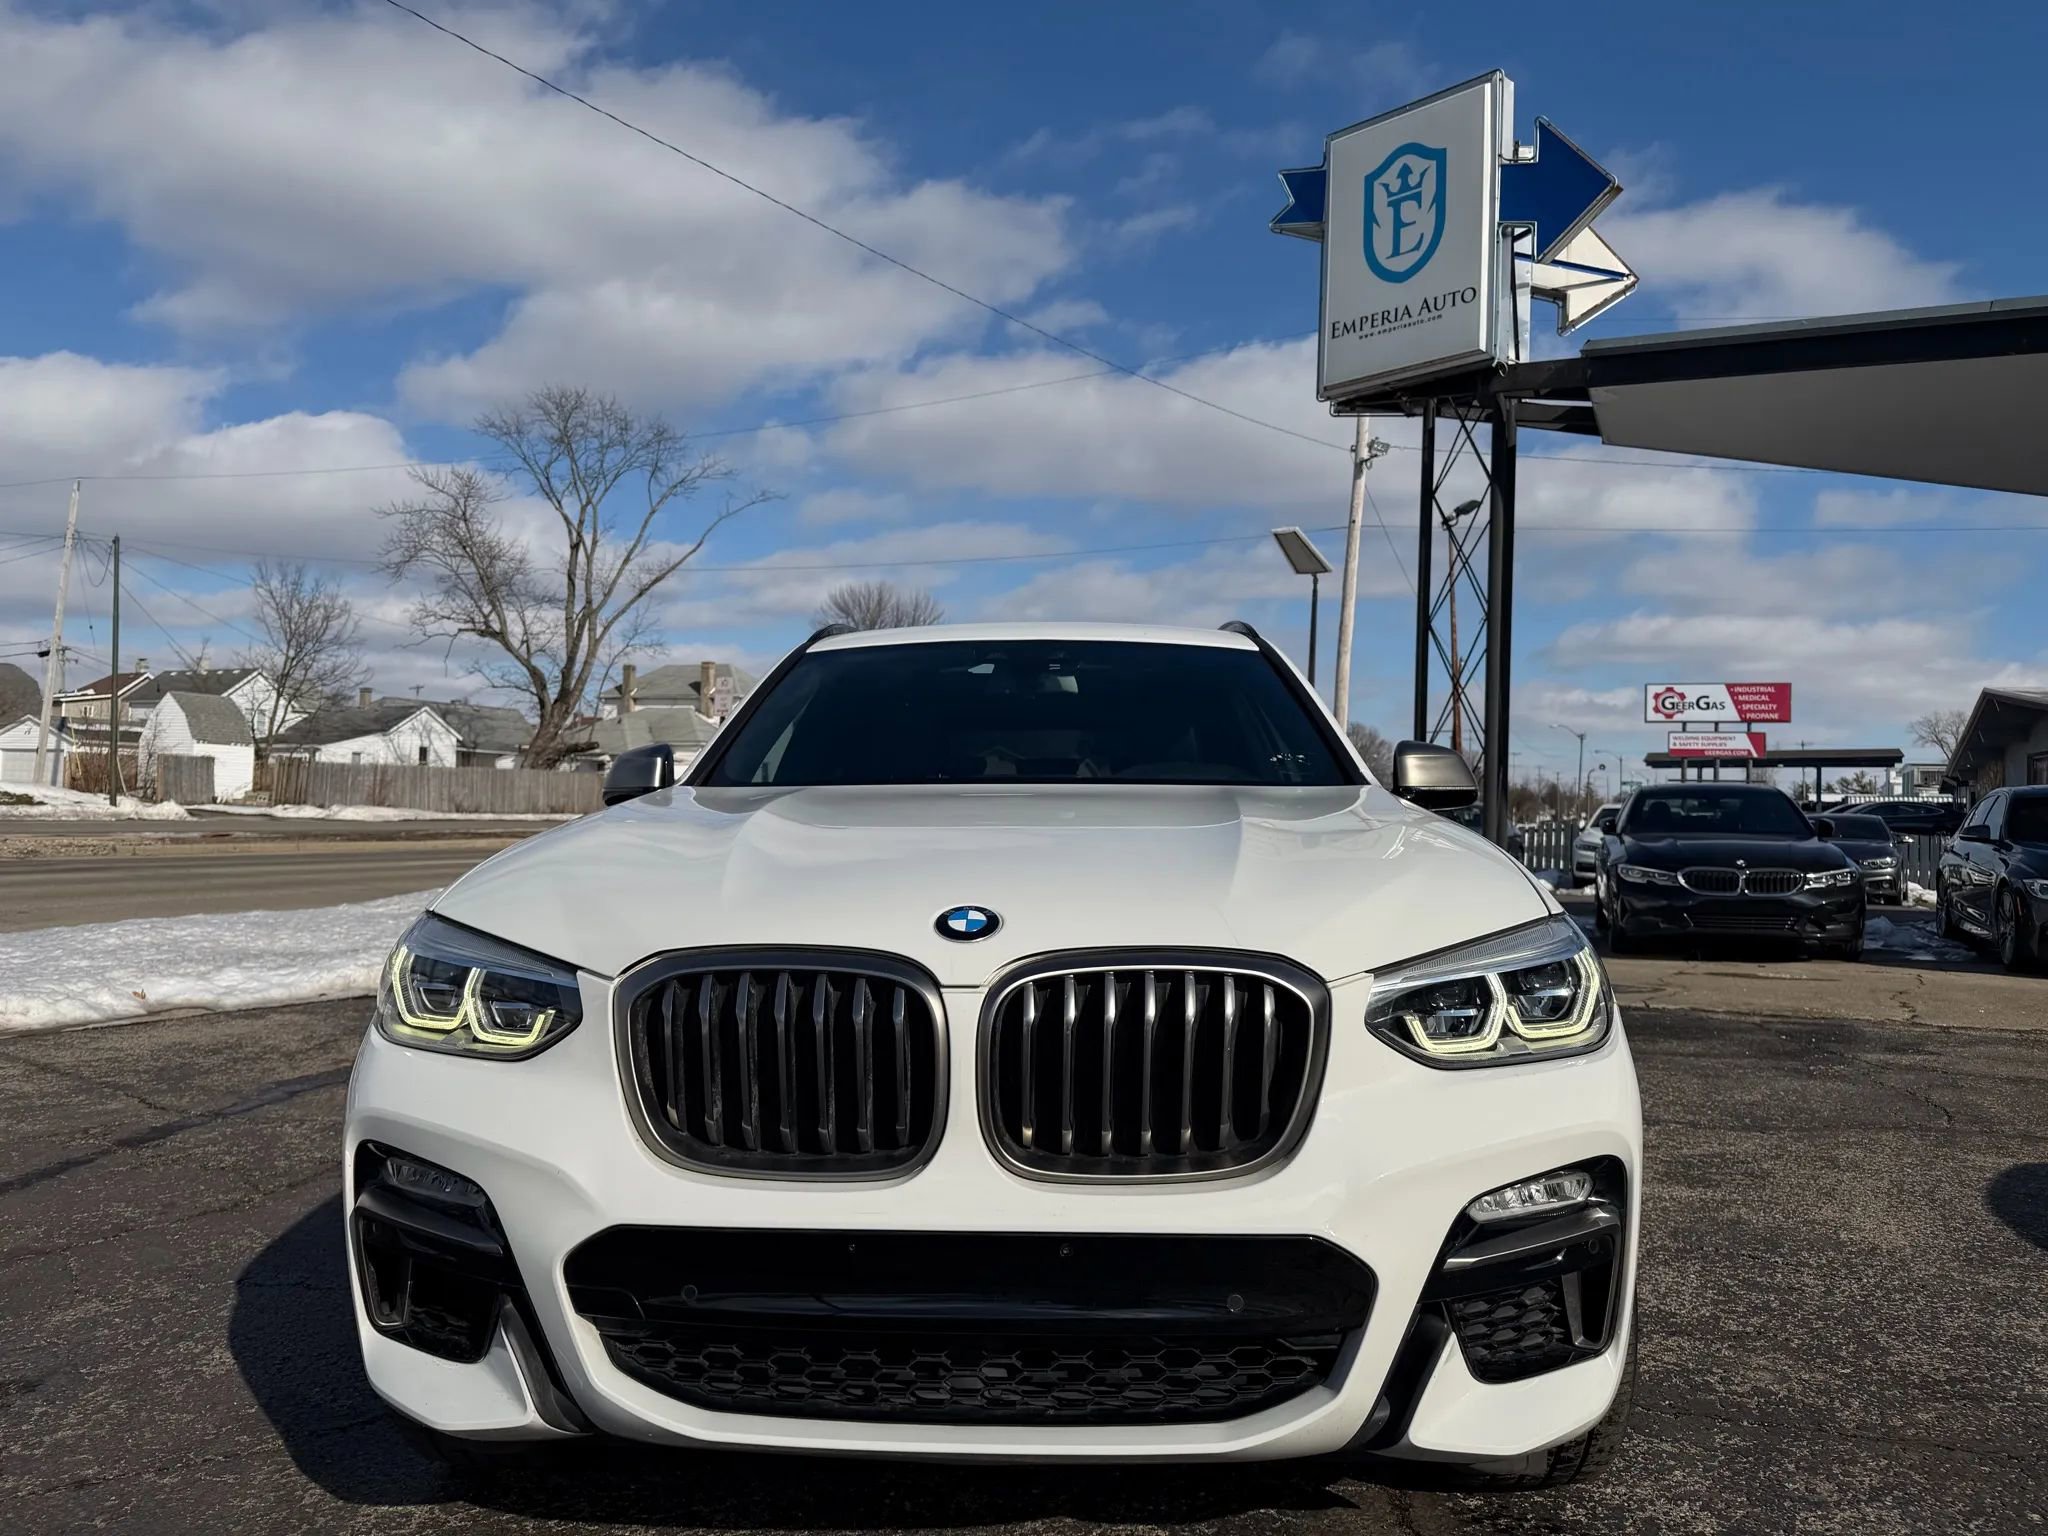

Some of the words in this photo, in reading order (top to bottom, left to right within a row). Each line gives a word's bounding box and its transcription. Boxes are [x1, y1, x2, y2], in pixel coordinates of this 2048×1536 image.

[1385, 194, 1424, 260] E
[1331, 304, 1413, 340] EMPERIA
[1417, 286, 1477, 317] AUTO
[1358, 314, 1443, 340] www.emperiaauto.com
[1742, 703, 1778, 711] SPECIALTY
[1746, 712, 1779, 720] PROPANE
